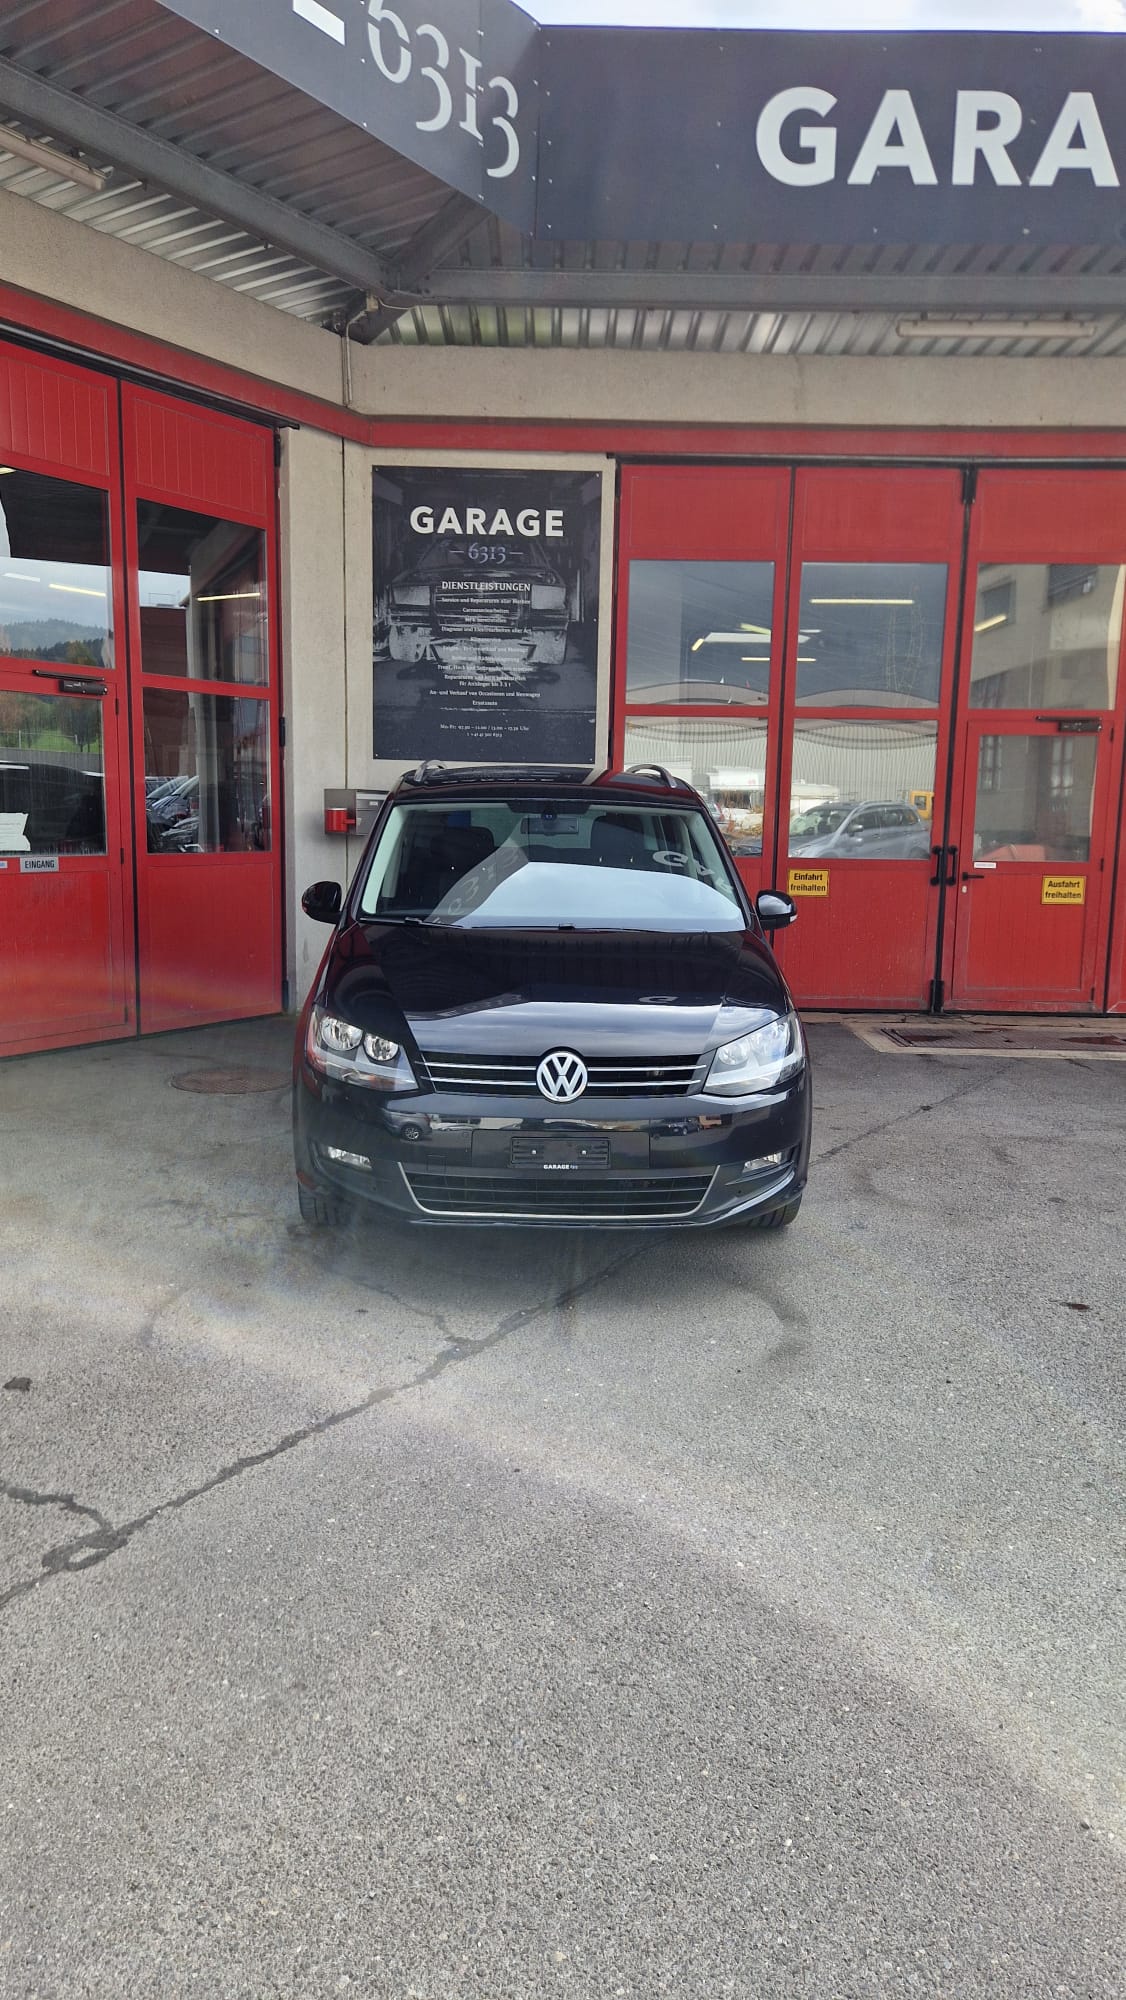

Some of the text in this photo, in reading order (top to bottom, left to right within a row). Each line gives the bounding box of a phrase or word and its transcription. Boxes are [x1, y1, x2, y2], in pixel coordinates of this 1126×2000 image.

[368, 0, 519, 178] 6313
[756, 86, 1120, 187] GARA
[410, 506, 564, 537] GARAGE
[468, 542, 506, 564] 6313
[441, 581, 531, 592] DIENSTLEISTUNGEN
[24, 860, 54, 868] EINGANG
[794, 872, 822, 880] Einfahrt
[790, 884, 826, 892] freihalten
[1048, 880, 1080, 888] Ausfahrt
